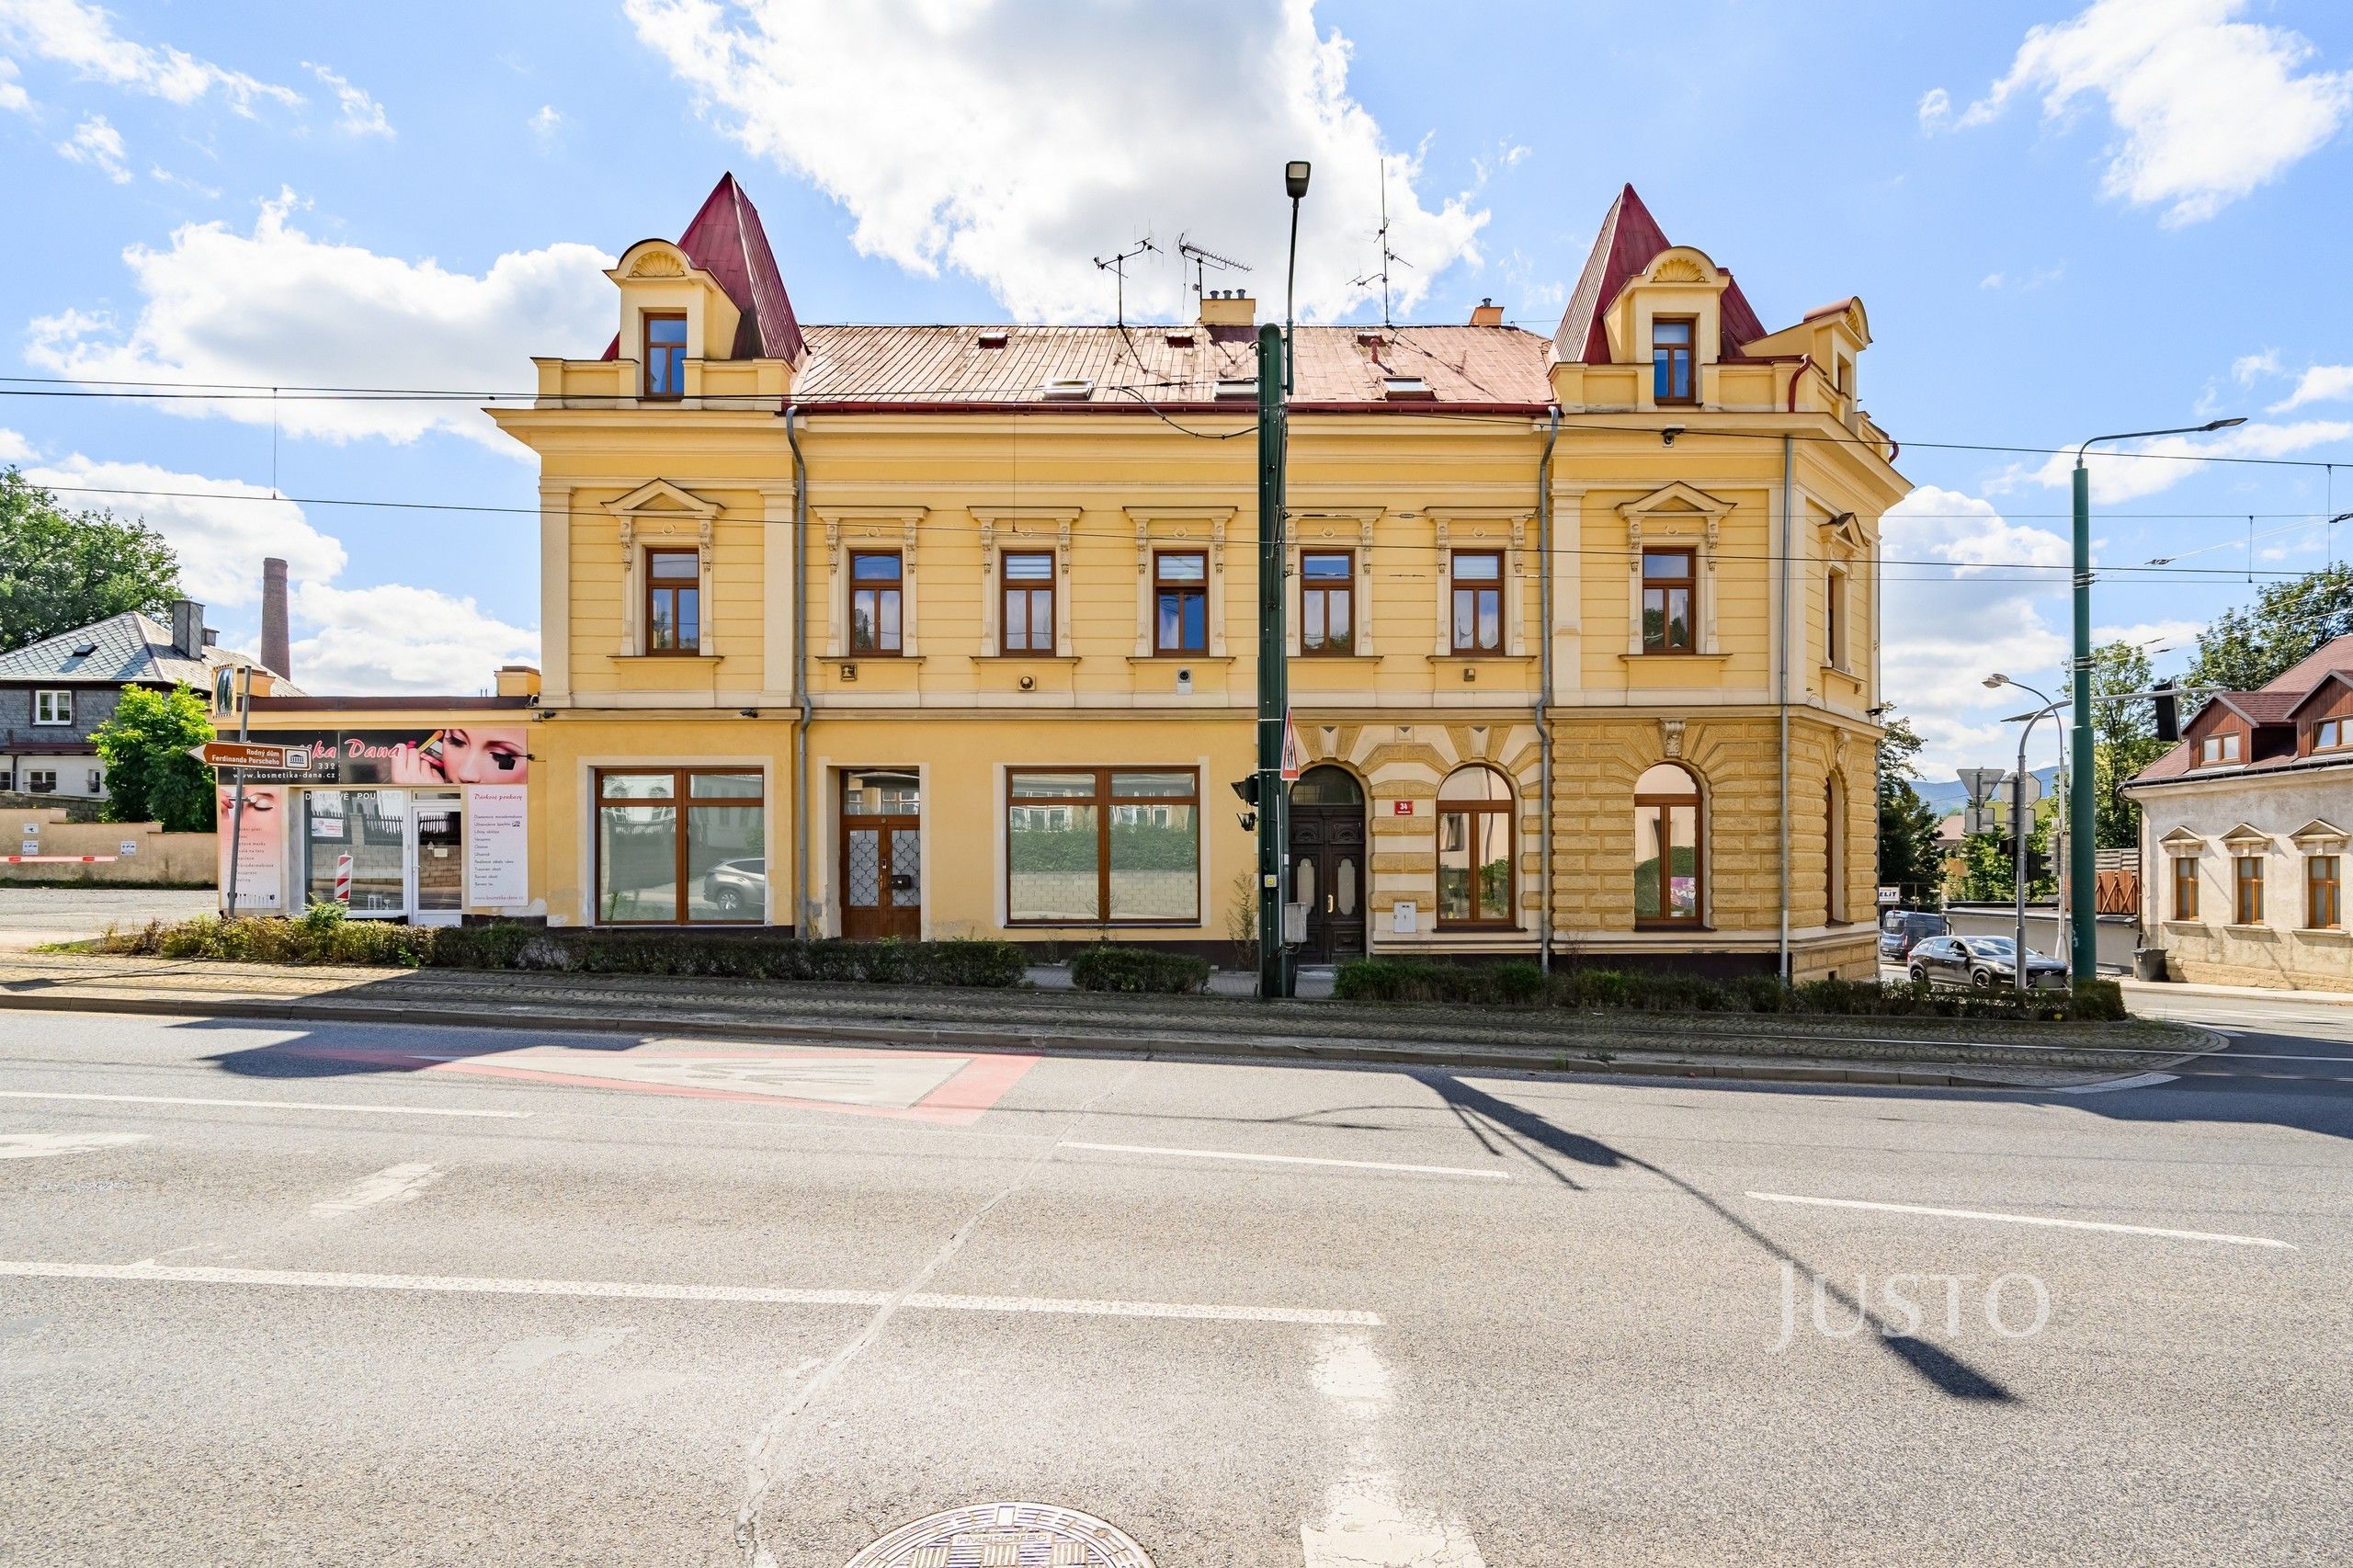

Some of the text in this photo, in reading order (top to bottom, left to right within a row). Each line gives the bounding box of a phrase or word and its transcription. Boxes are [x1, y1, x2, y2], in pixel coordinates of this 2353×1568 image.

[246, 748, 265, 756] Rodný
[344, 738, 400, 758] Dana
[211, 755, 280, 766] Ferdinanda Porscheho
[957, 1533, 1049, 1544] HYDROTEC
